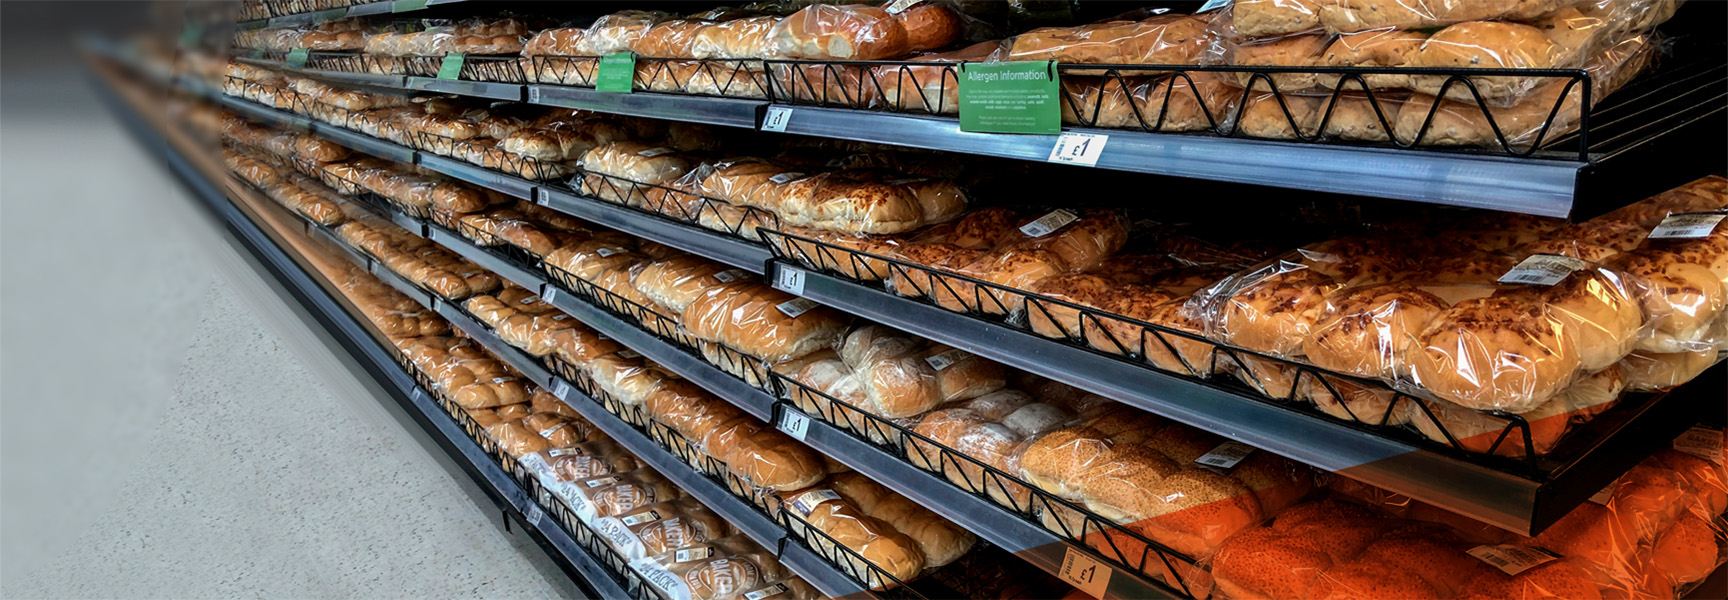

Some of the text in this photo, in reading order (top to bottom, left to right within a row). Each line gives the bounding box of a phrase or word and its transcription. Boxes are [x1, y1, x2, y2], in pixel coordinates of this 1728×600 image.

[967, 70, 1047, 82] Allergen Information
[773, 111, 784, 125] £1
[1071, 138, 1091, 157] £1
[789, 272, 798, 287] £1
[792, 418, 802, 432] £1
[1080, 565, 1096, 583] £1
